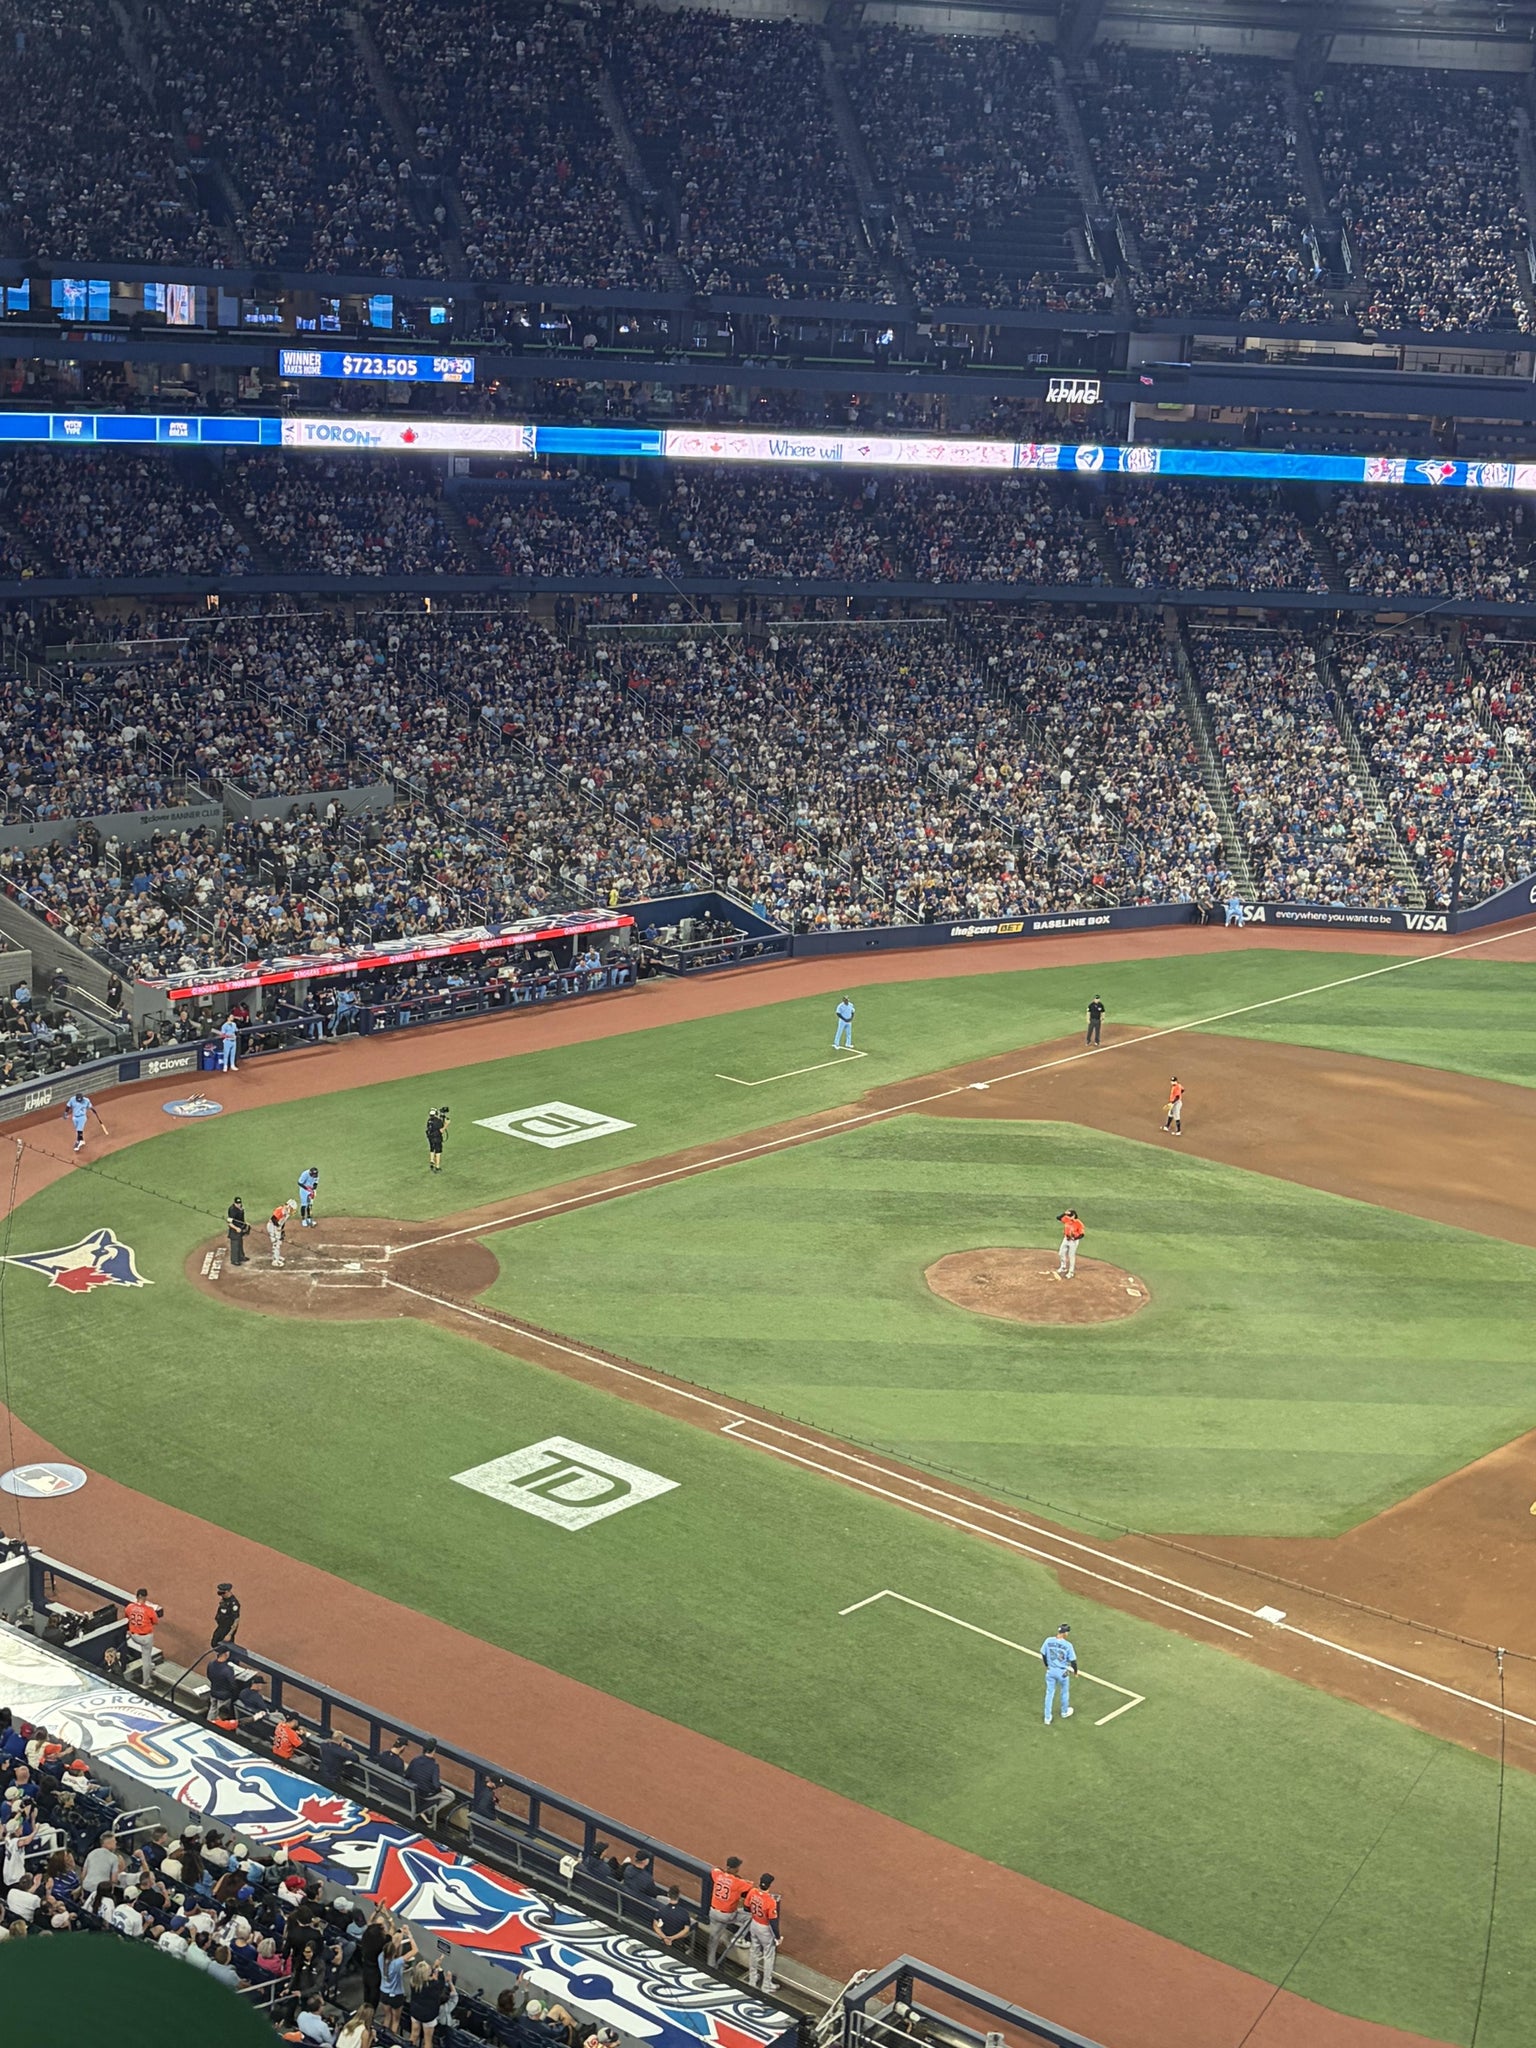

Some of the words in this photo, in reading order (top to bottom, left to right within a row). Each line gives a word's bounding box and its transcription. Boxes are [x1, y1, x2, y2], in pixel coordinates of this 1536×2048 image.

[284, 352, 321, 366] WINNER
[343, 356, 418, 375] $723,505
[1046, 385, 1099, 404] KPMG
[769, 440, 816, 457] Where
[819, 444, 843, 460] will
[201, 808, 220, 818] CLUB
[999, 922, 1022, 933] BET
[1033, 917, 1086, 930] BASELINE
[1088, 915, 1110, 925] BOX
[1276, 911, 1328, 920] everywhere
[1328, 914, 1345, 923] you
[1346, 914, 1368, 923] want
[1369, 915, 1379, 923] to
[1380, 915, 1391, 924] be
[1402, 913, 1448, 932] VISA
[160, 1057, 190, 1070] clover
[24, 1091, 52, 1111] KPMG
[508, 1112, 610, 1138] TD
[509, 1450, 632, 1508] TD
[73, 1696, 181, 1720] TOROO
[714, 1883, 730, 1900] 23
